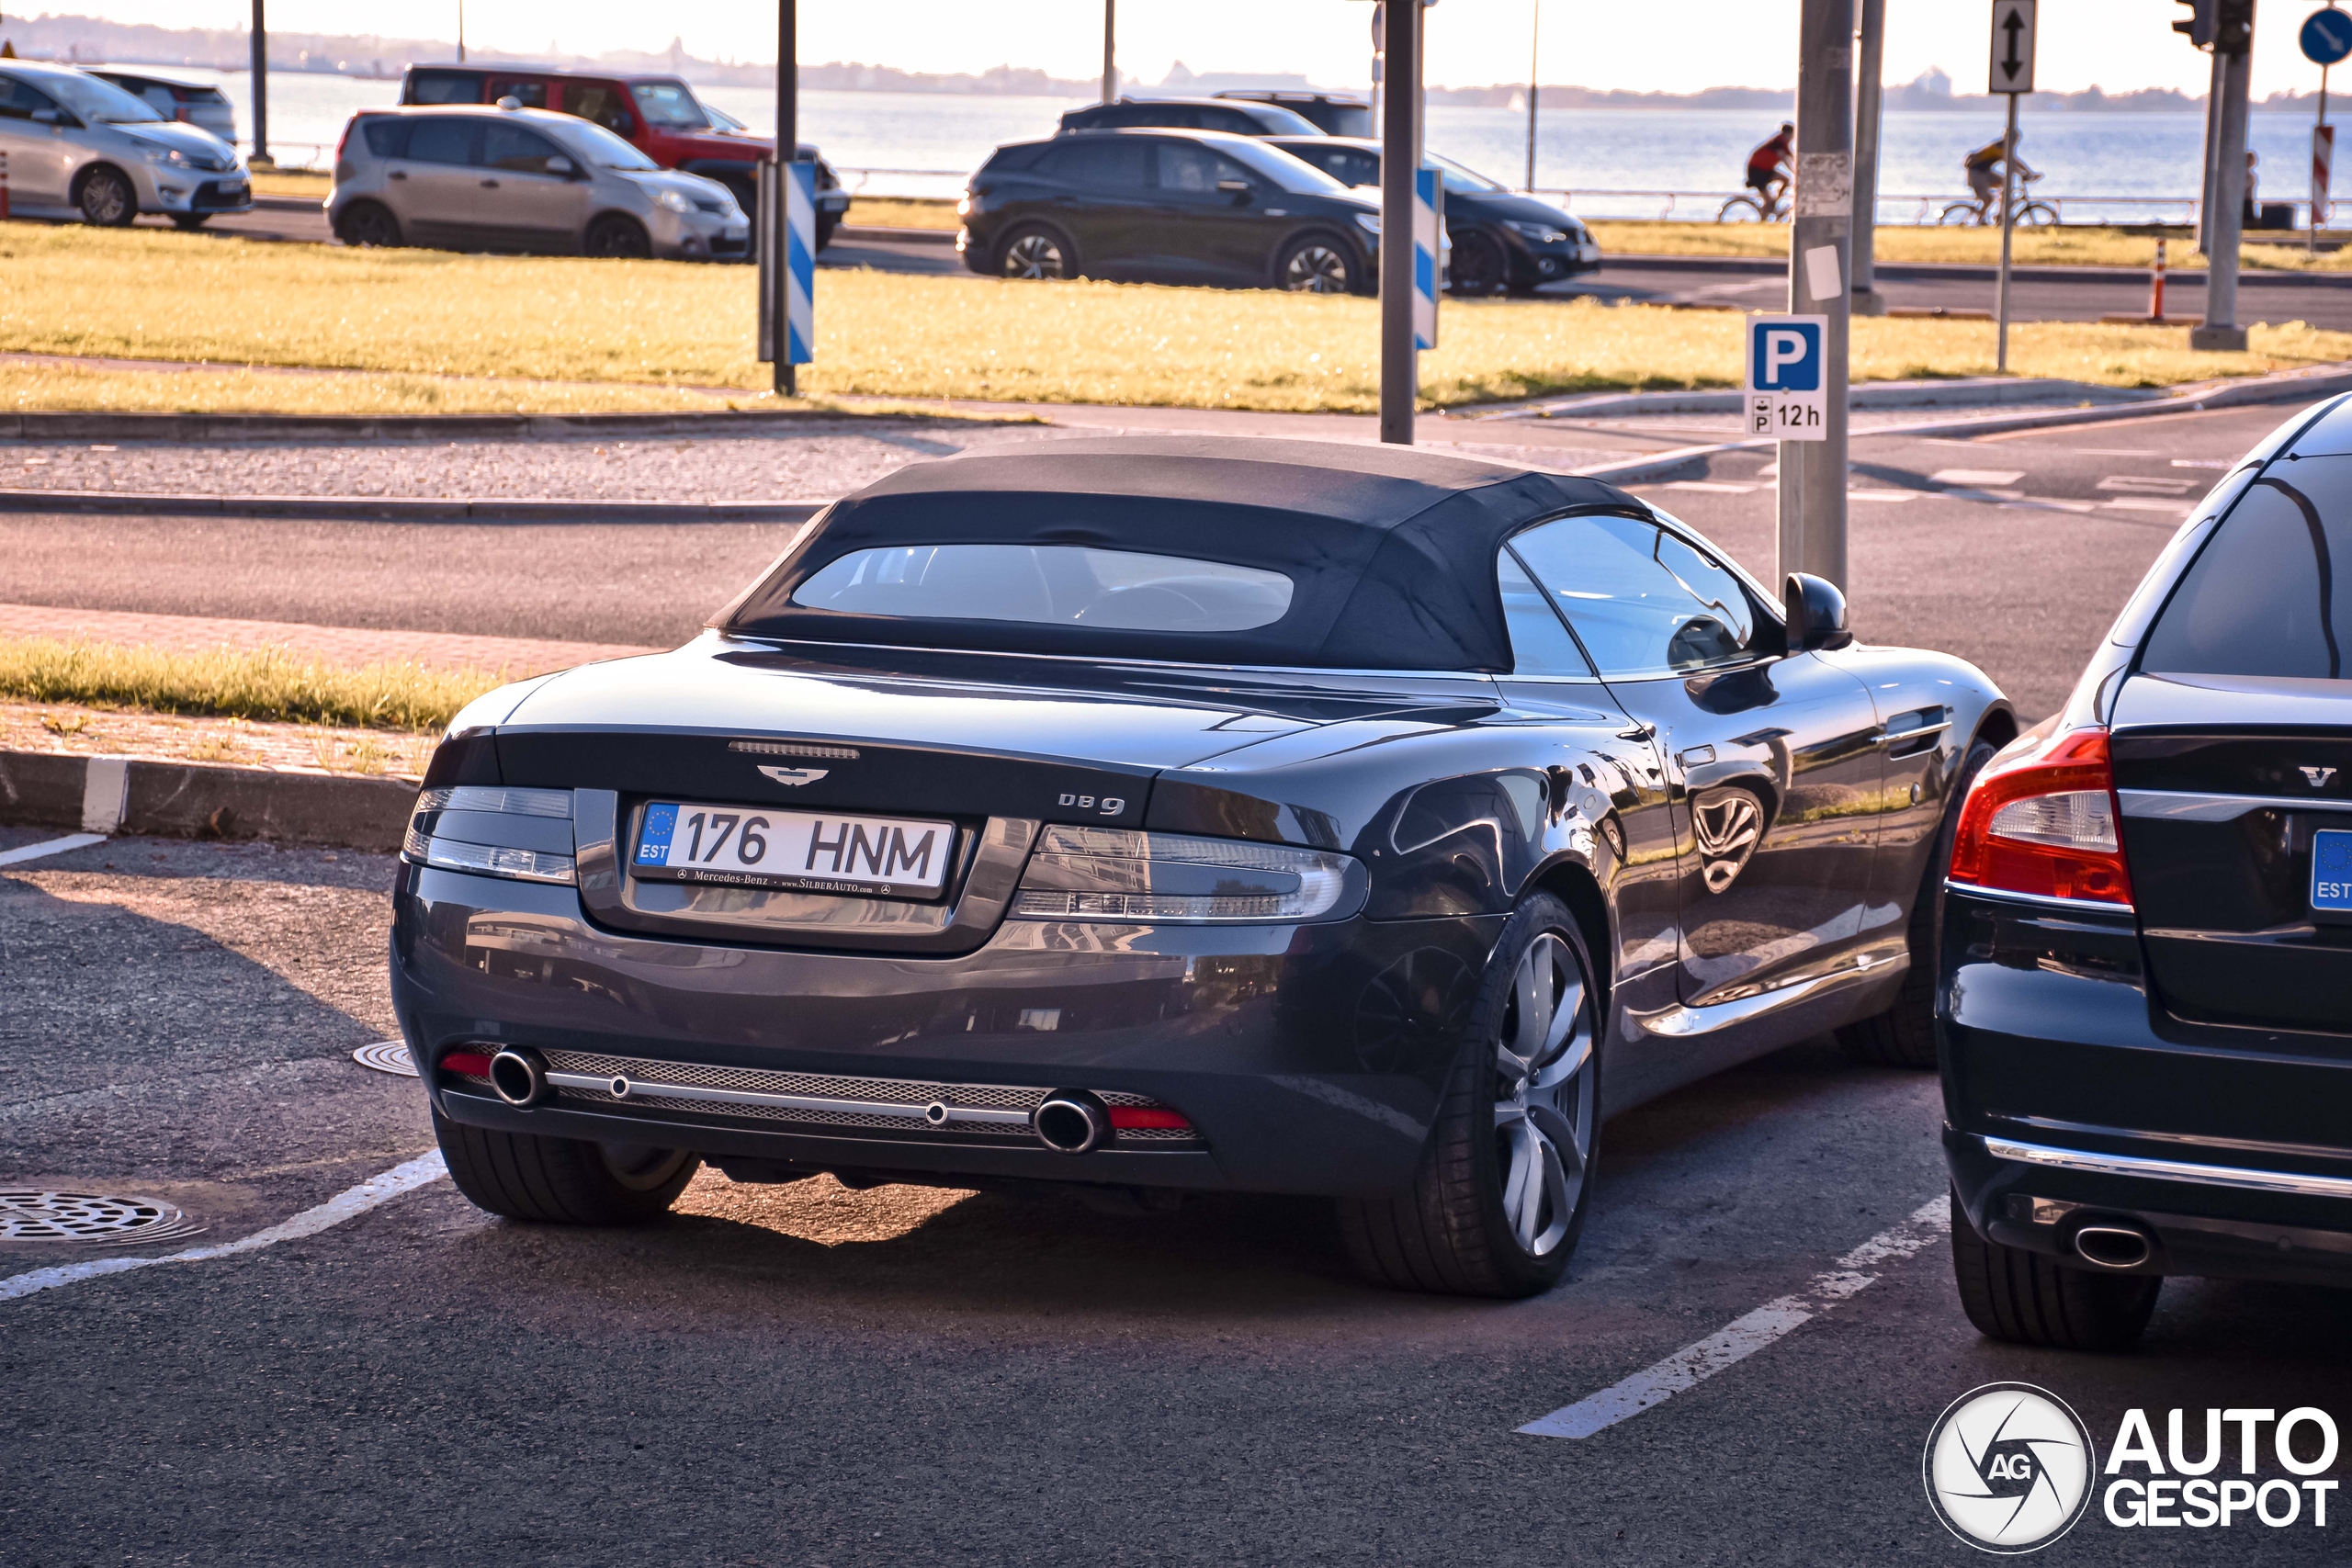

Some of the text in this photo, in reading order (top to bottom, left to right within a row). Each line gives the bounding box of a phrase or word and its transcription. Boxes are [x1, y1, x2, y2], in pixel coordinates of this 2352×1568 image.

[1766, 330, 1807, 384] P
[1058, 794, 1125, 816] DB9
[640, 844, 668, 859] EST
[687, 812, 935, 879] 176 HNM
[694, 870, 768, 886] Mercedes-Benz
